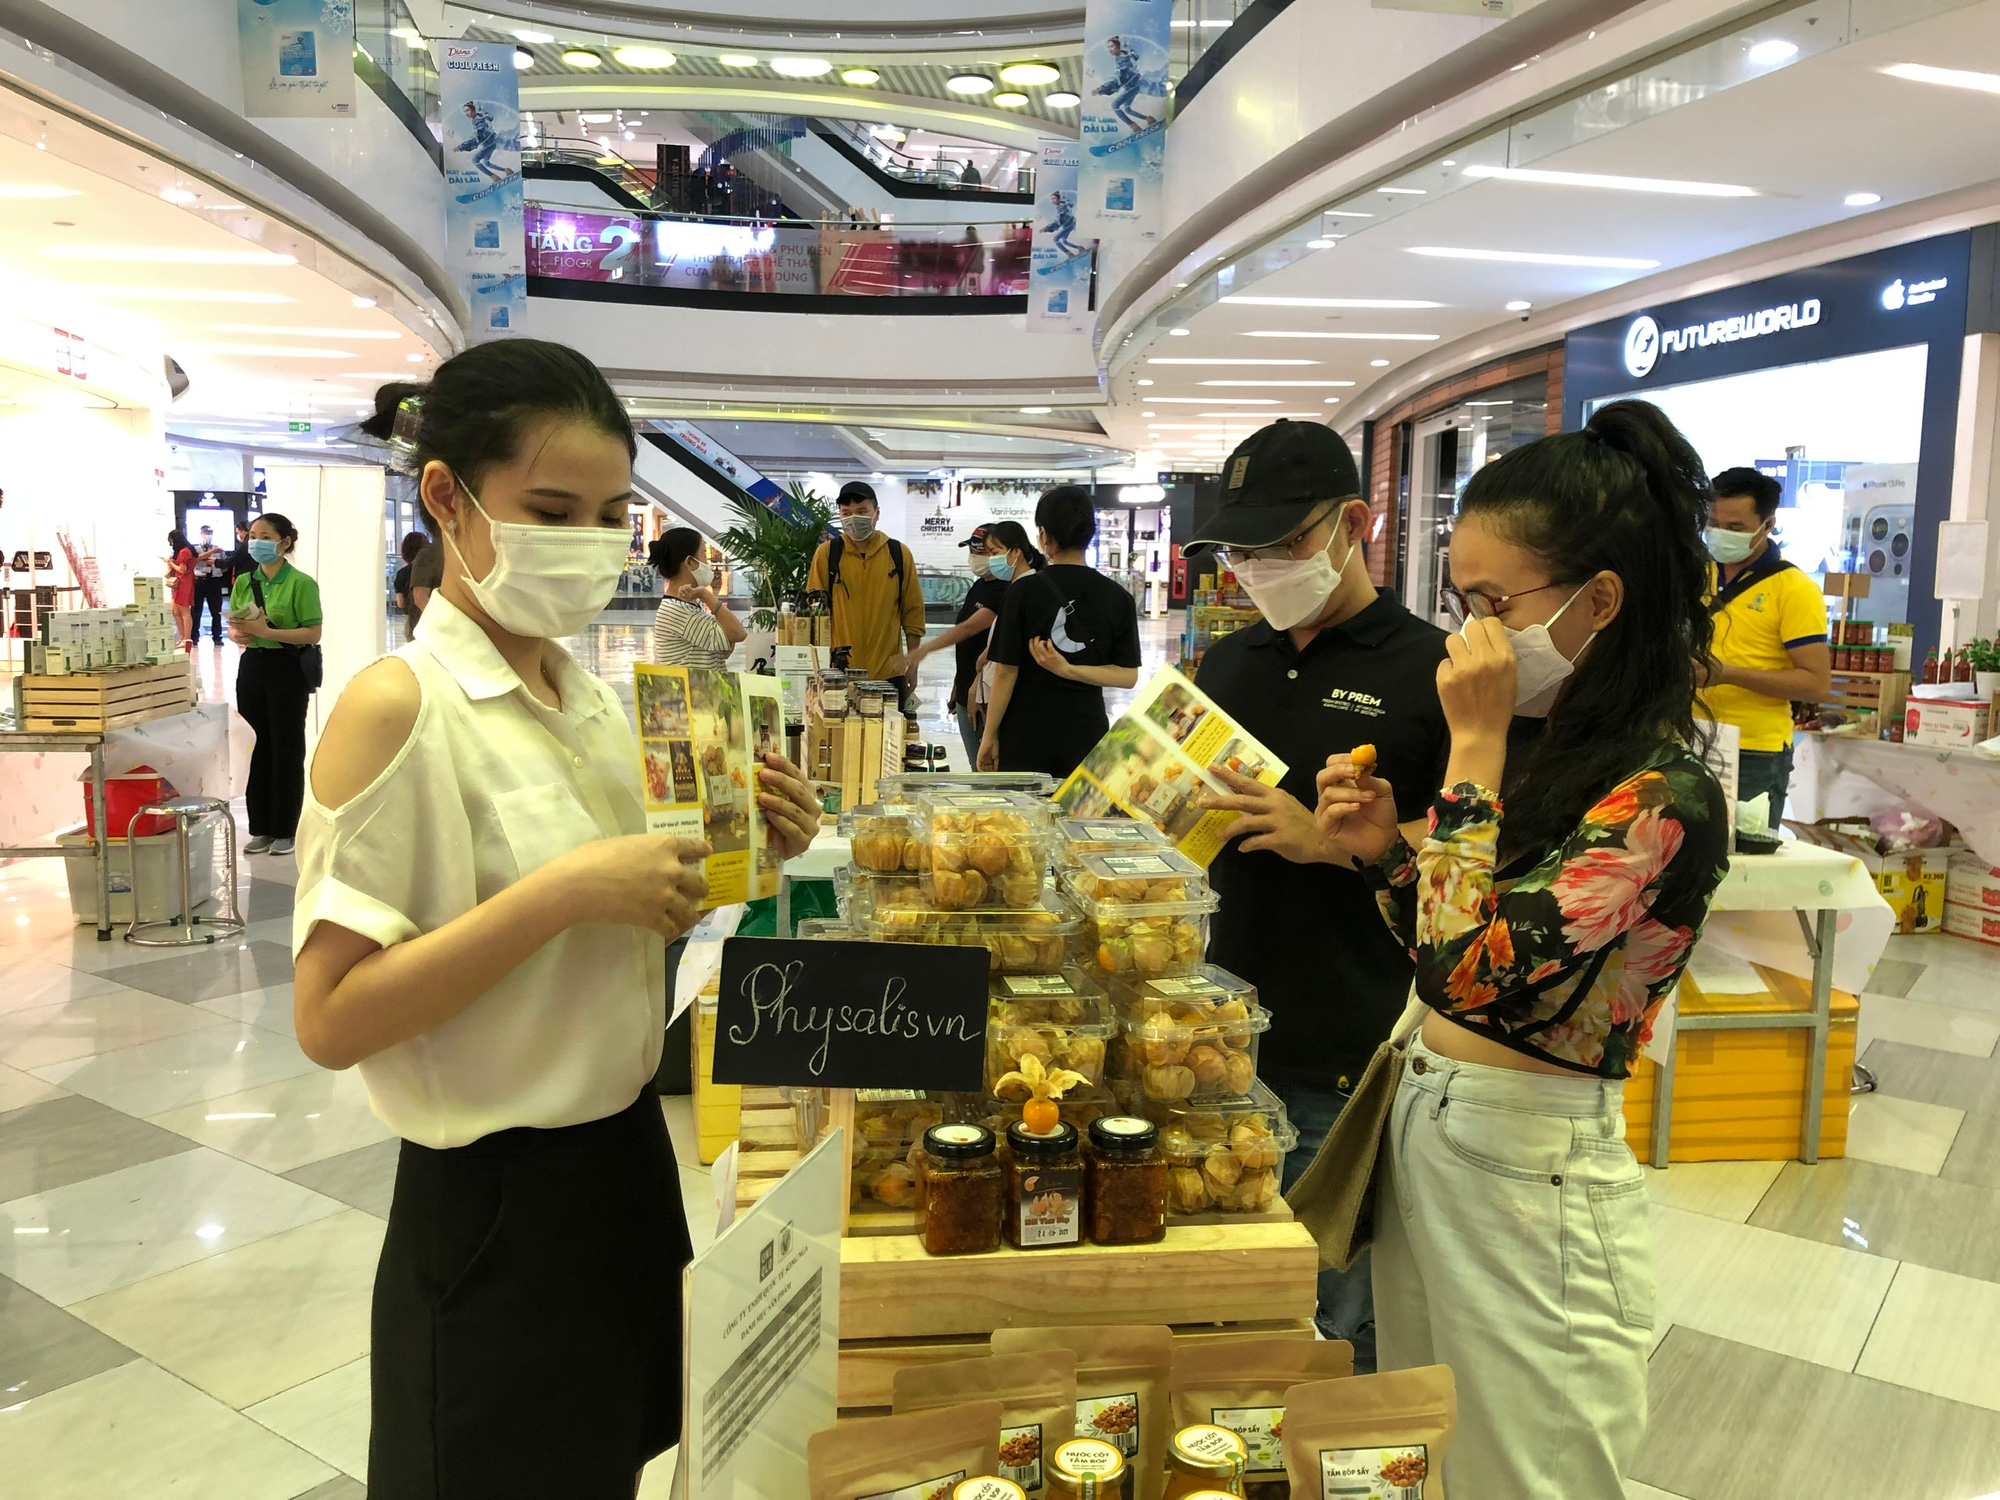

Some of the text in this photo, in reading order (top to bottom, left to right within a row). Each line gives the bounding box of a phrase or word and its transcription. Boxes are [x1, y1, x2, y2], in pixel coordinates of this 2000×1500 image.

[447, 47, 471, 57] Diana
[447, 60, 499, 71] COOL FRESH
[1083, 123, 1100, 133] DÀI
[1108, 137, 1133, 153] COOL
[448, 176, 464, 184] DÀI
[472, 185, 494, 201] COOL
[599, 225, 641, 273] 2
[554, 256, 593, 269] FLOOR
[1662, 298, 1821, 355] FUTUREWORLD
[1868, 480, 1887, 488] iPhone
[924, 517, 951, 526] MERRY
[920, 525, 954, 533] CHRISTMAS
[1330, 688, 1349, 699] BY
[1346, 691, 1383, 707] PREM
[722, 1317, 739, 1340] CÔNG
[741, 1322, 757, 1341] DANH
[1247, 1424, 1260, 1433] SẤY
[1187, 1431, 1218, 1450] NƯỚC CỐT
[1196, 1437, 1223, 1453] TẦM BÓP
[1066, 1450, 1110, 1458] NƯỚC CỐT
[1326, 1465, 1370, 1477] TẦM BÓP SẤY
